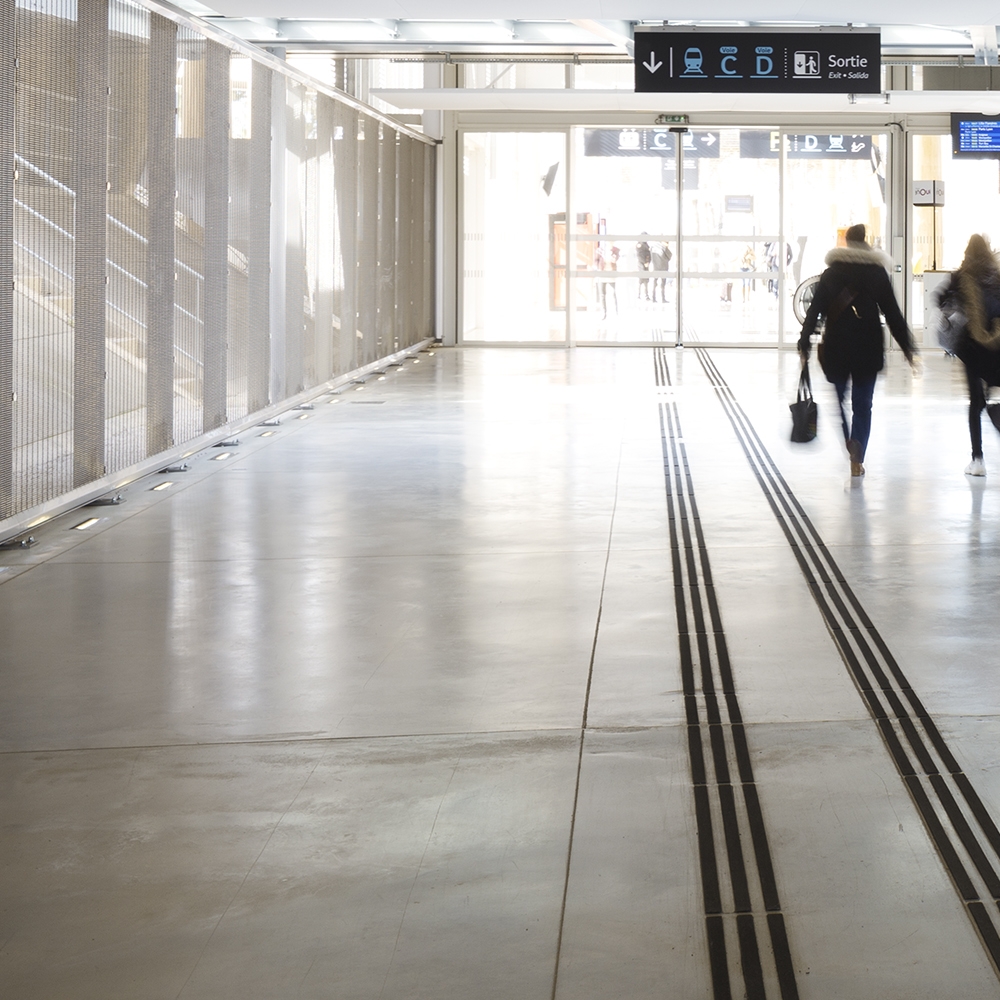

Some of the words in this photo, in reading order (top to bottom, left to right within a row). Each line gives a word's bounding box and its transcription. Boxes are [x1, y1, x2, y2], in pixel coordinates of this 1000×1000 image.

[720, 55, 737, 75] C
[756, 55, 773, 75] D
[828, 54, 868, 68] Sortie
[828, 71, 842, 79] Exit
[847, 71, 869, 79] Salida
[653, 132, 668, 148] C
[804, 134, 818, 149] D
